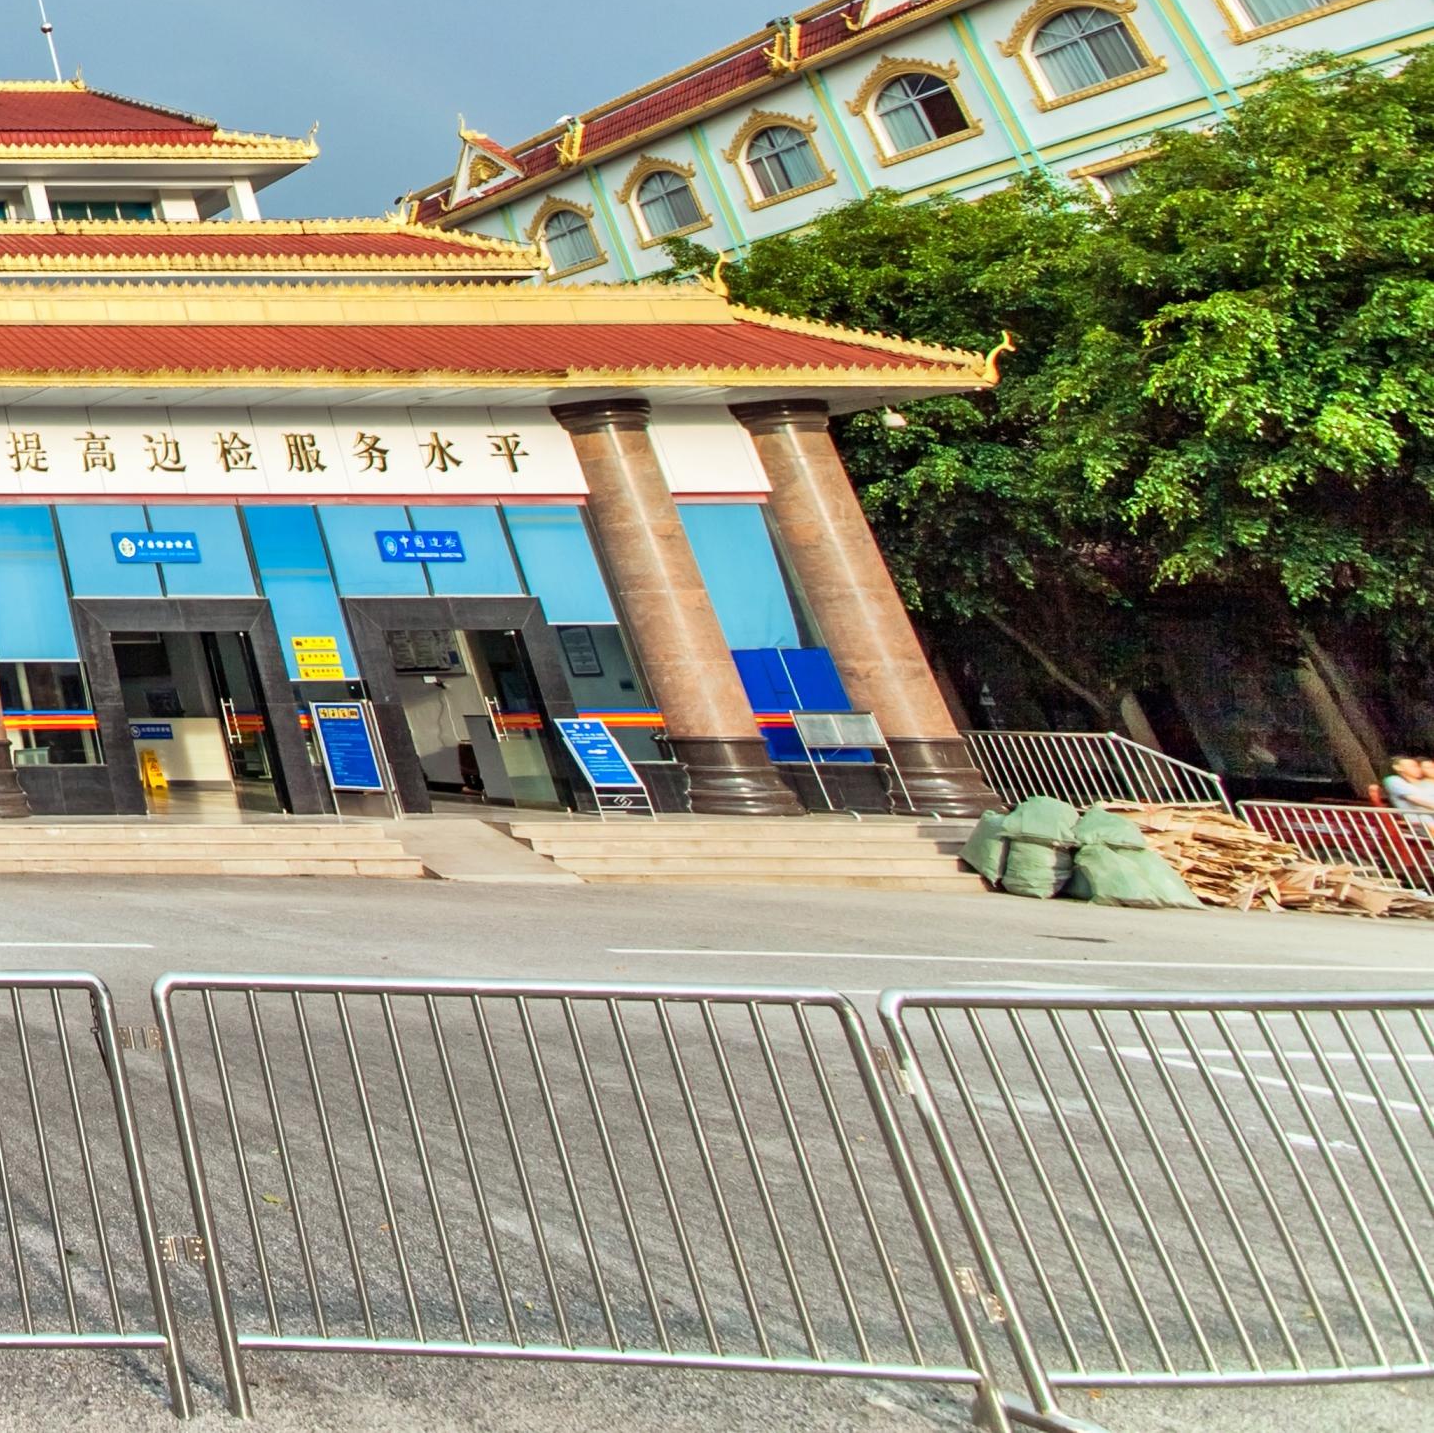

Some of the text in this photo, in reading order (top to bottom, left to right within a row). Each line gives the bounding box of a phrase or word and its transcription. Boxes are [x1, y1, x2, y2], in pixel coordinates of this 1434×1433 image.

[5, 431, 530, 474] 提高边检服务水平
